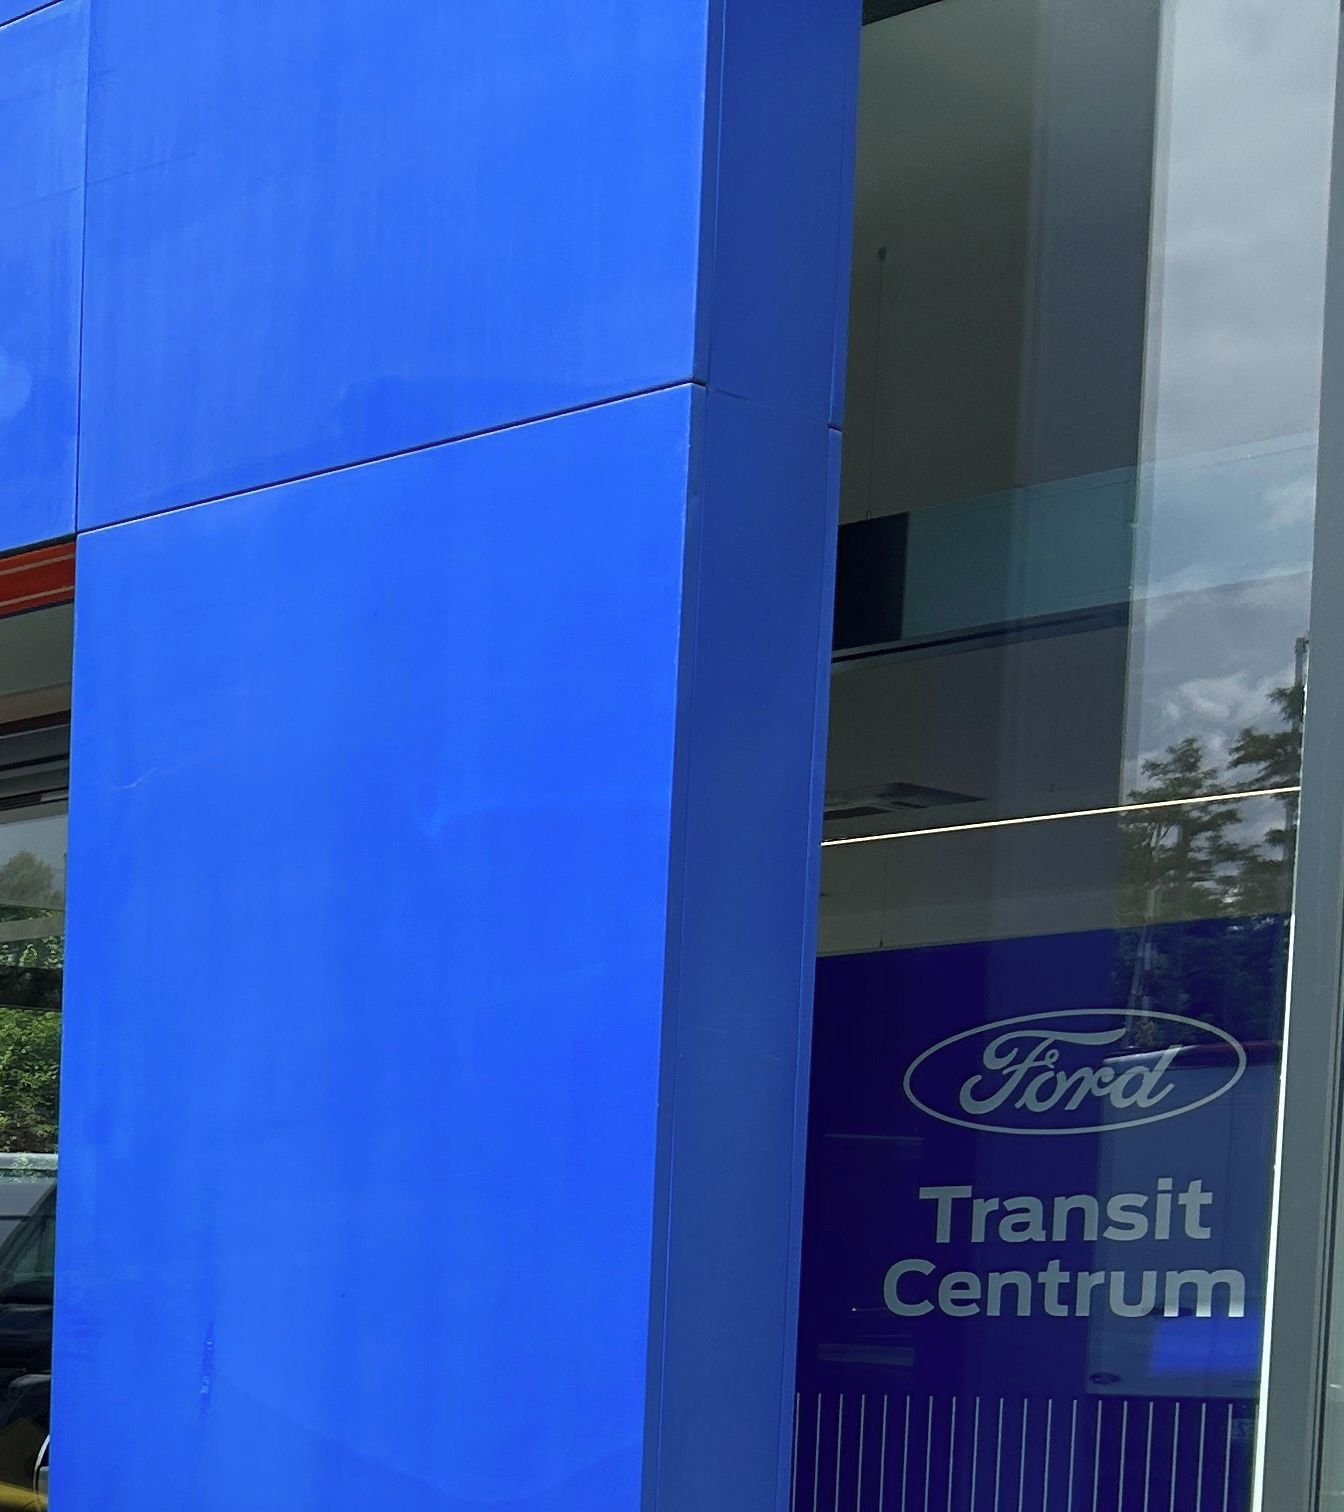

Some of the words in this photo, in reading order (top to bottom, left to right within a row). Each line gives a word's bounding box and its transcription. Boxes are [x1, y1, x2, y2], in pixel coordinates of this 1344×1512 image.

[959, 1027, 1183, 1115] Ford
[919, 1177, 1213, 1244] Transit
[883, 1259, 1246, 1318] Centrum
